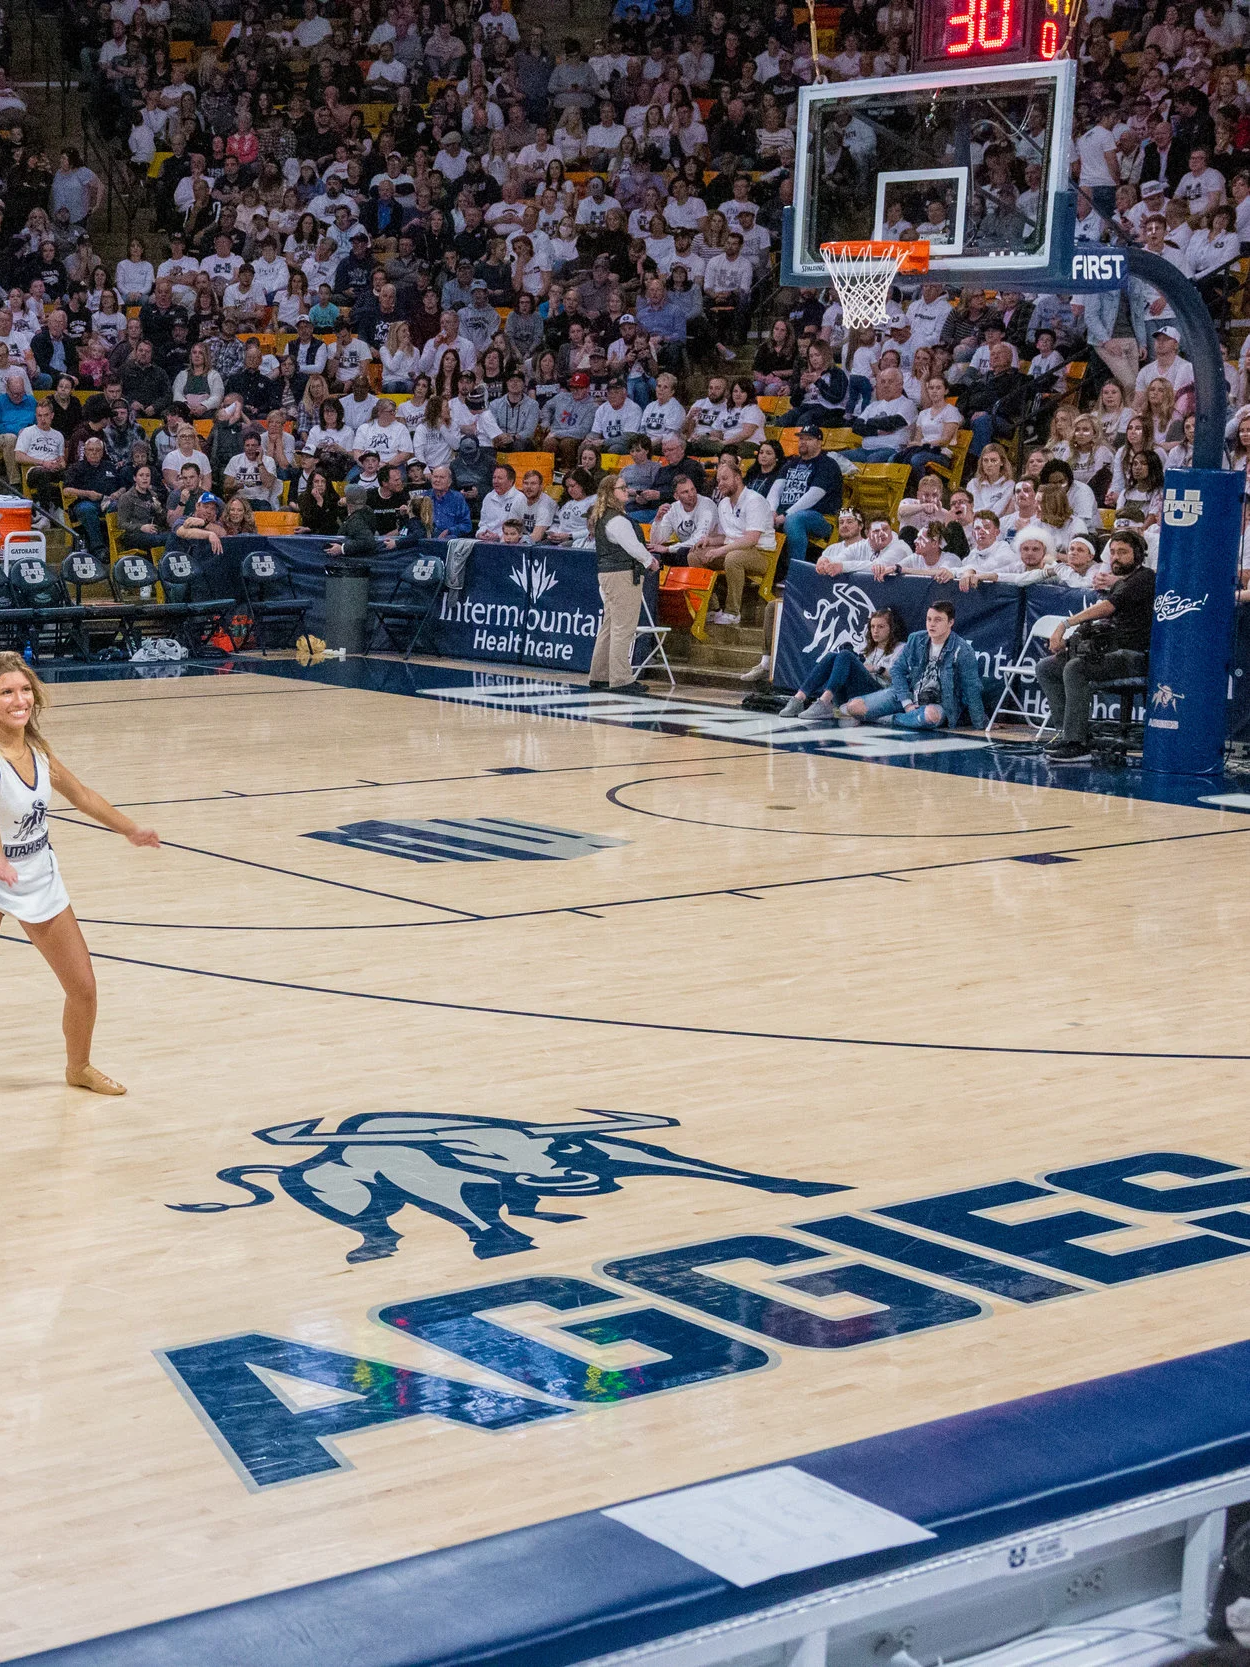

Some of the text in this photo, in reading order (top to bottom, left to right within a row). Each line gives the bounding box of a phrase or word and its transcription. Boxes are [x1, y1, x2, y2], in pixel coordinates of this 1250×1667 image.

[948, 0, 1010, 53] 30
[1071, 254, 1126, 280] FIRST
[236, 473, 260, 481] STAT
[1164, 500, 1204, 516] STATE
[439, 591, 605, 638] Intermountai
[473, 629, 574, 661] Healthcare
[4, 842, 35, 859] UTAH
